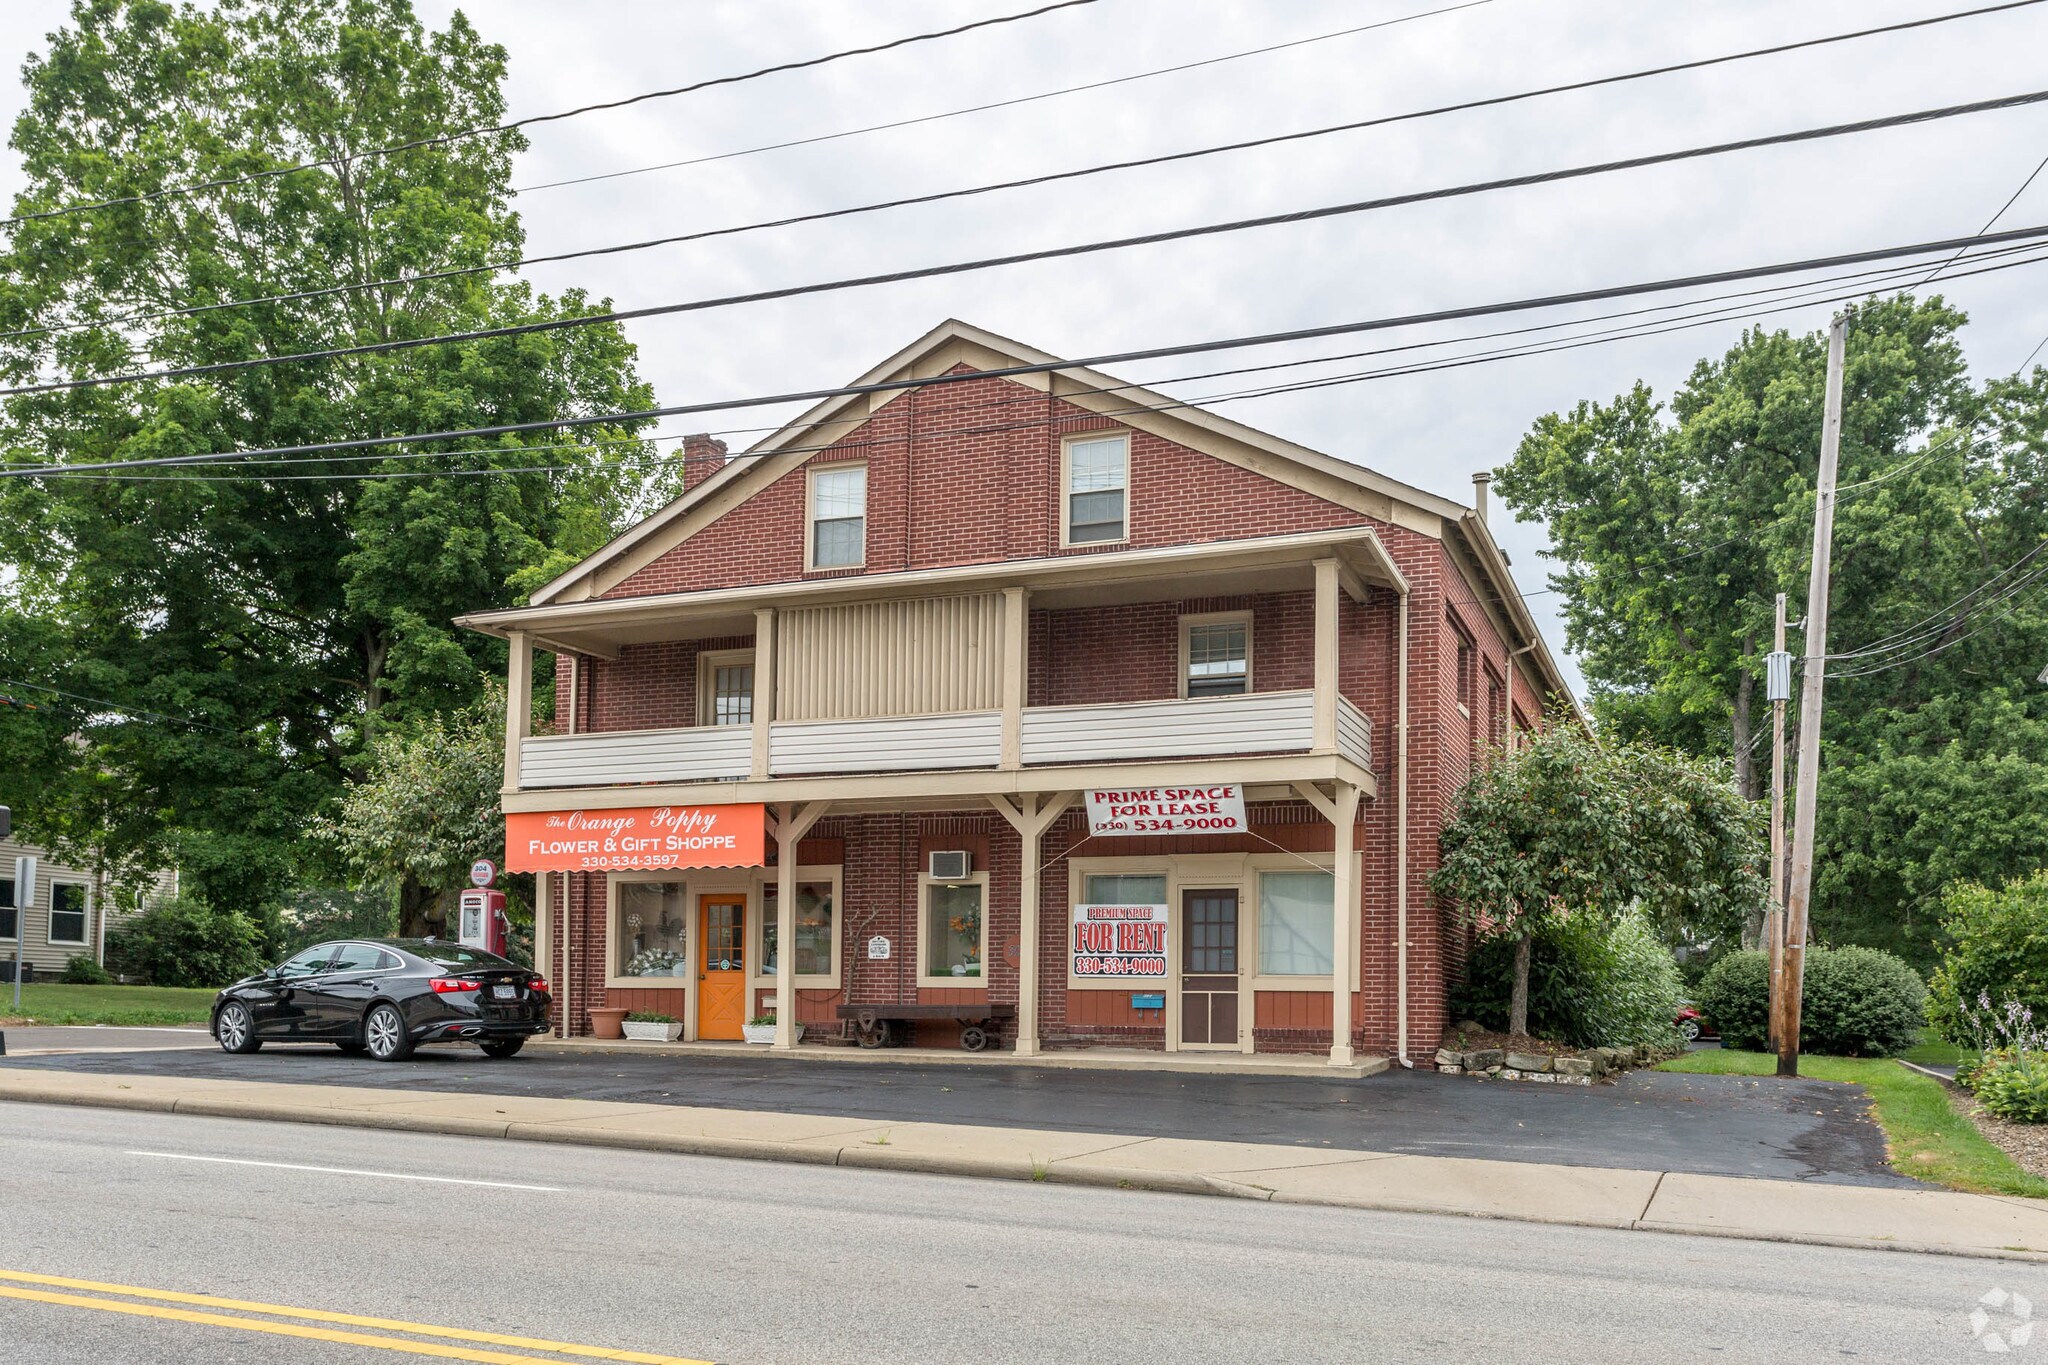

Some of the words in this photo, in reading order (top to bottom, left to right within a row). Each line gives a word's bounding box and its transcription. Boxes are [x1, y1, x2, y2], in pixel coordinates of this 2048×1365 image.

[1094, 789, 1162, 803] PRIME
[1165, 787, 1236, 801] SPACE
[1110, 804, 1153, 818] FOR
[1157, 802, 1222, 816] LEASE
[546, 815, 566, 828] The
[567, 810, 636, 837] Orange
[649, 807, 718, 834] Poppy
[1095, 821, 1129, 832] (330)
[1134, 817, 1237, 831] 534-9000
[529, 839, 599, 855] FLOWER
[603, 837, 617, 852] &
[621, 836, 661, 852] GIFT
[666, 835, 736, 851] SHOPPE
[581, 854, 679, 868] 330-534-3597
[1088, 907, 1127, 920] PREMIUM
[1127, 907, 1153, 920] SPACE
[1074, 922, 1114, 954] FOR
[1116, 922, 1167, 954] RENT
[1075, 957, 1165, 974] 330-534-9000
